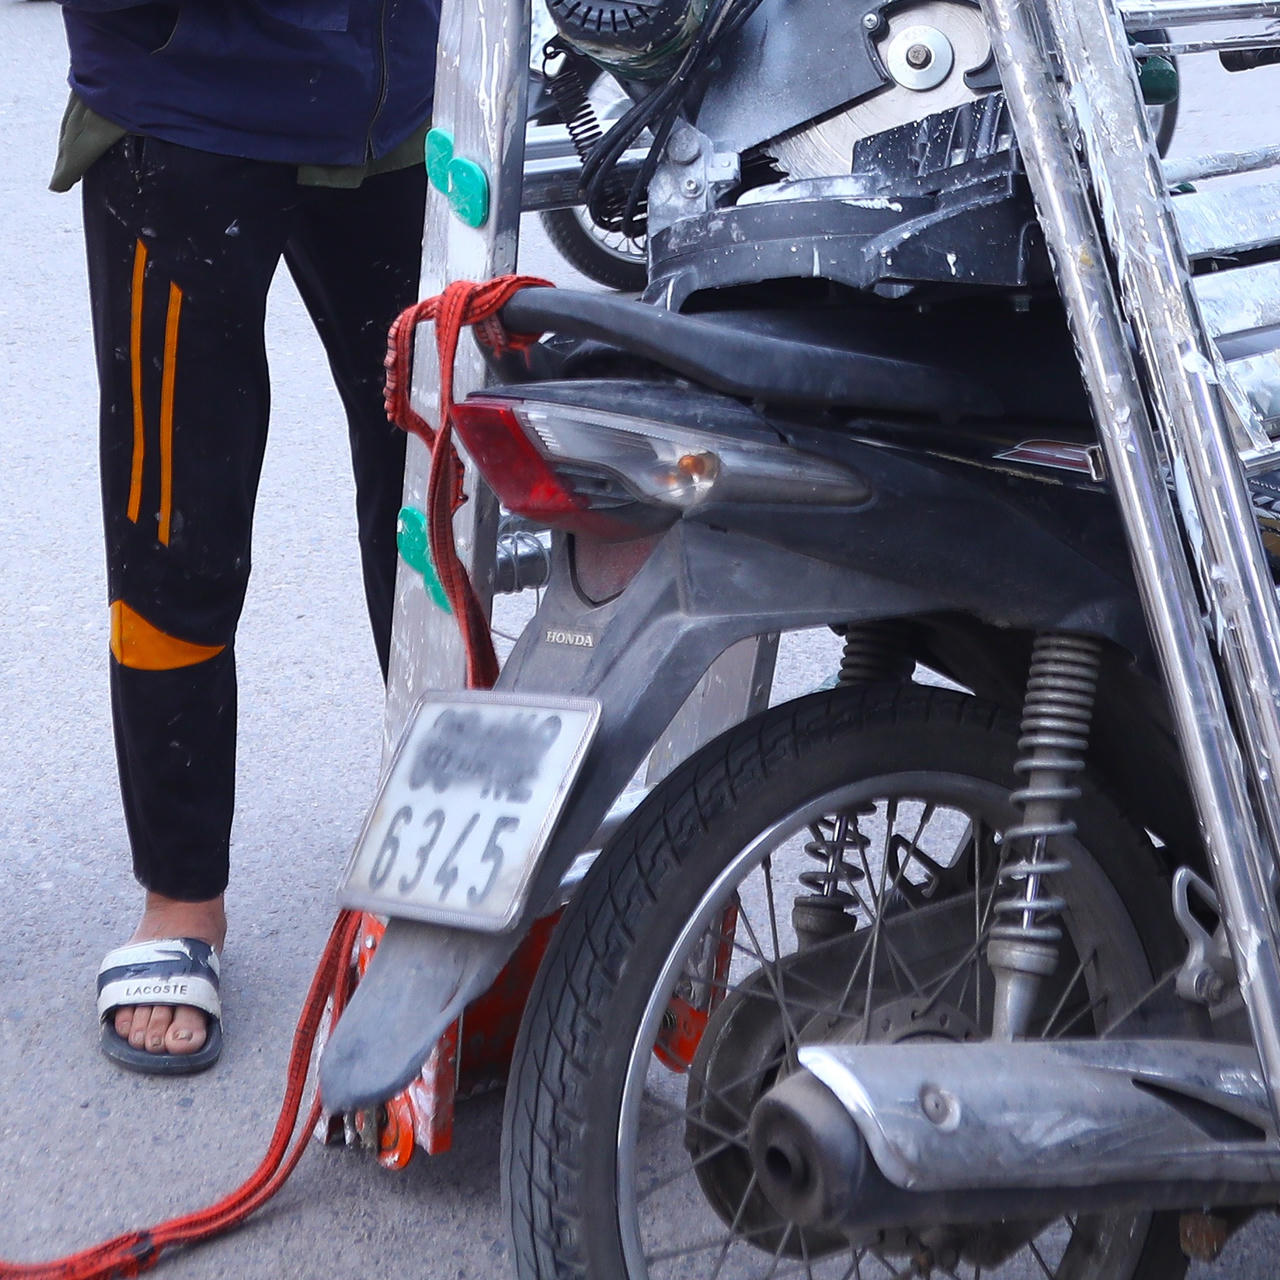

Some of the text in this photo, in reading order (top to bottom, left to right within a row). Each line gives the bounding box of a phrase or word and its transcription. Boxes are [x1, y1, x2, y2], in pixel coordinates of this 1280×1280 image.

[546, 631, 593, 647] HONDA
[368, 805, 520, 906] 6345
[126, 984, 188, 997] LACOSTE
